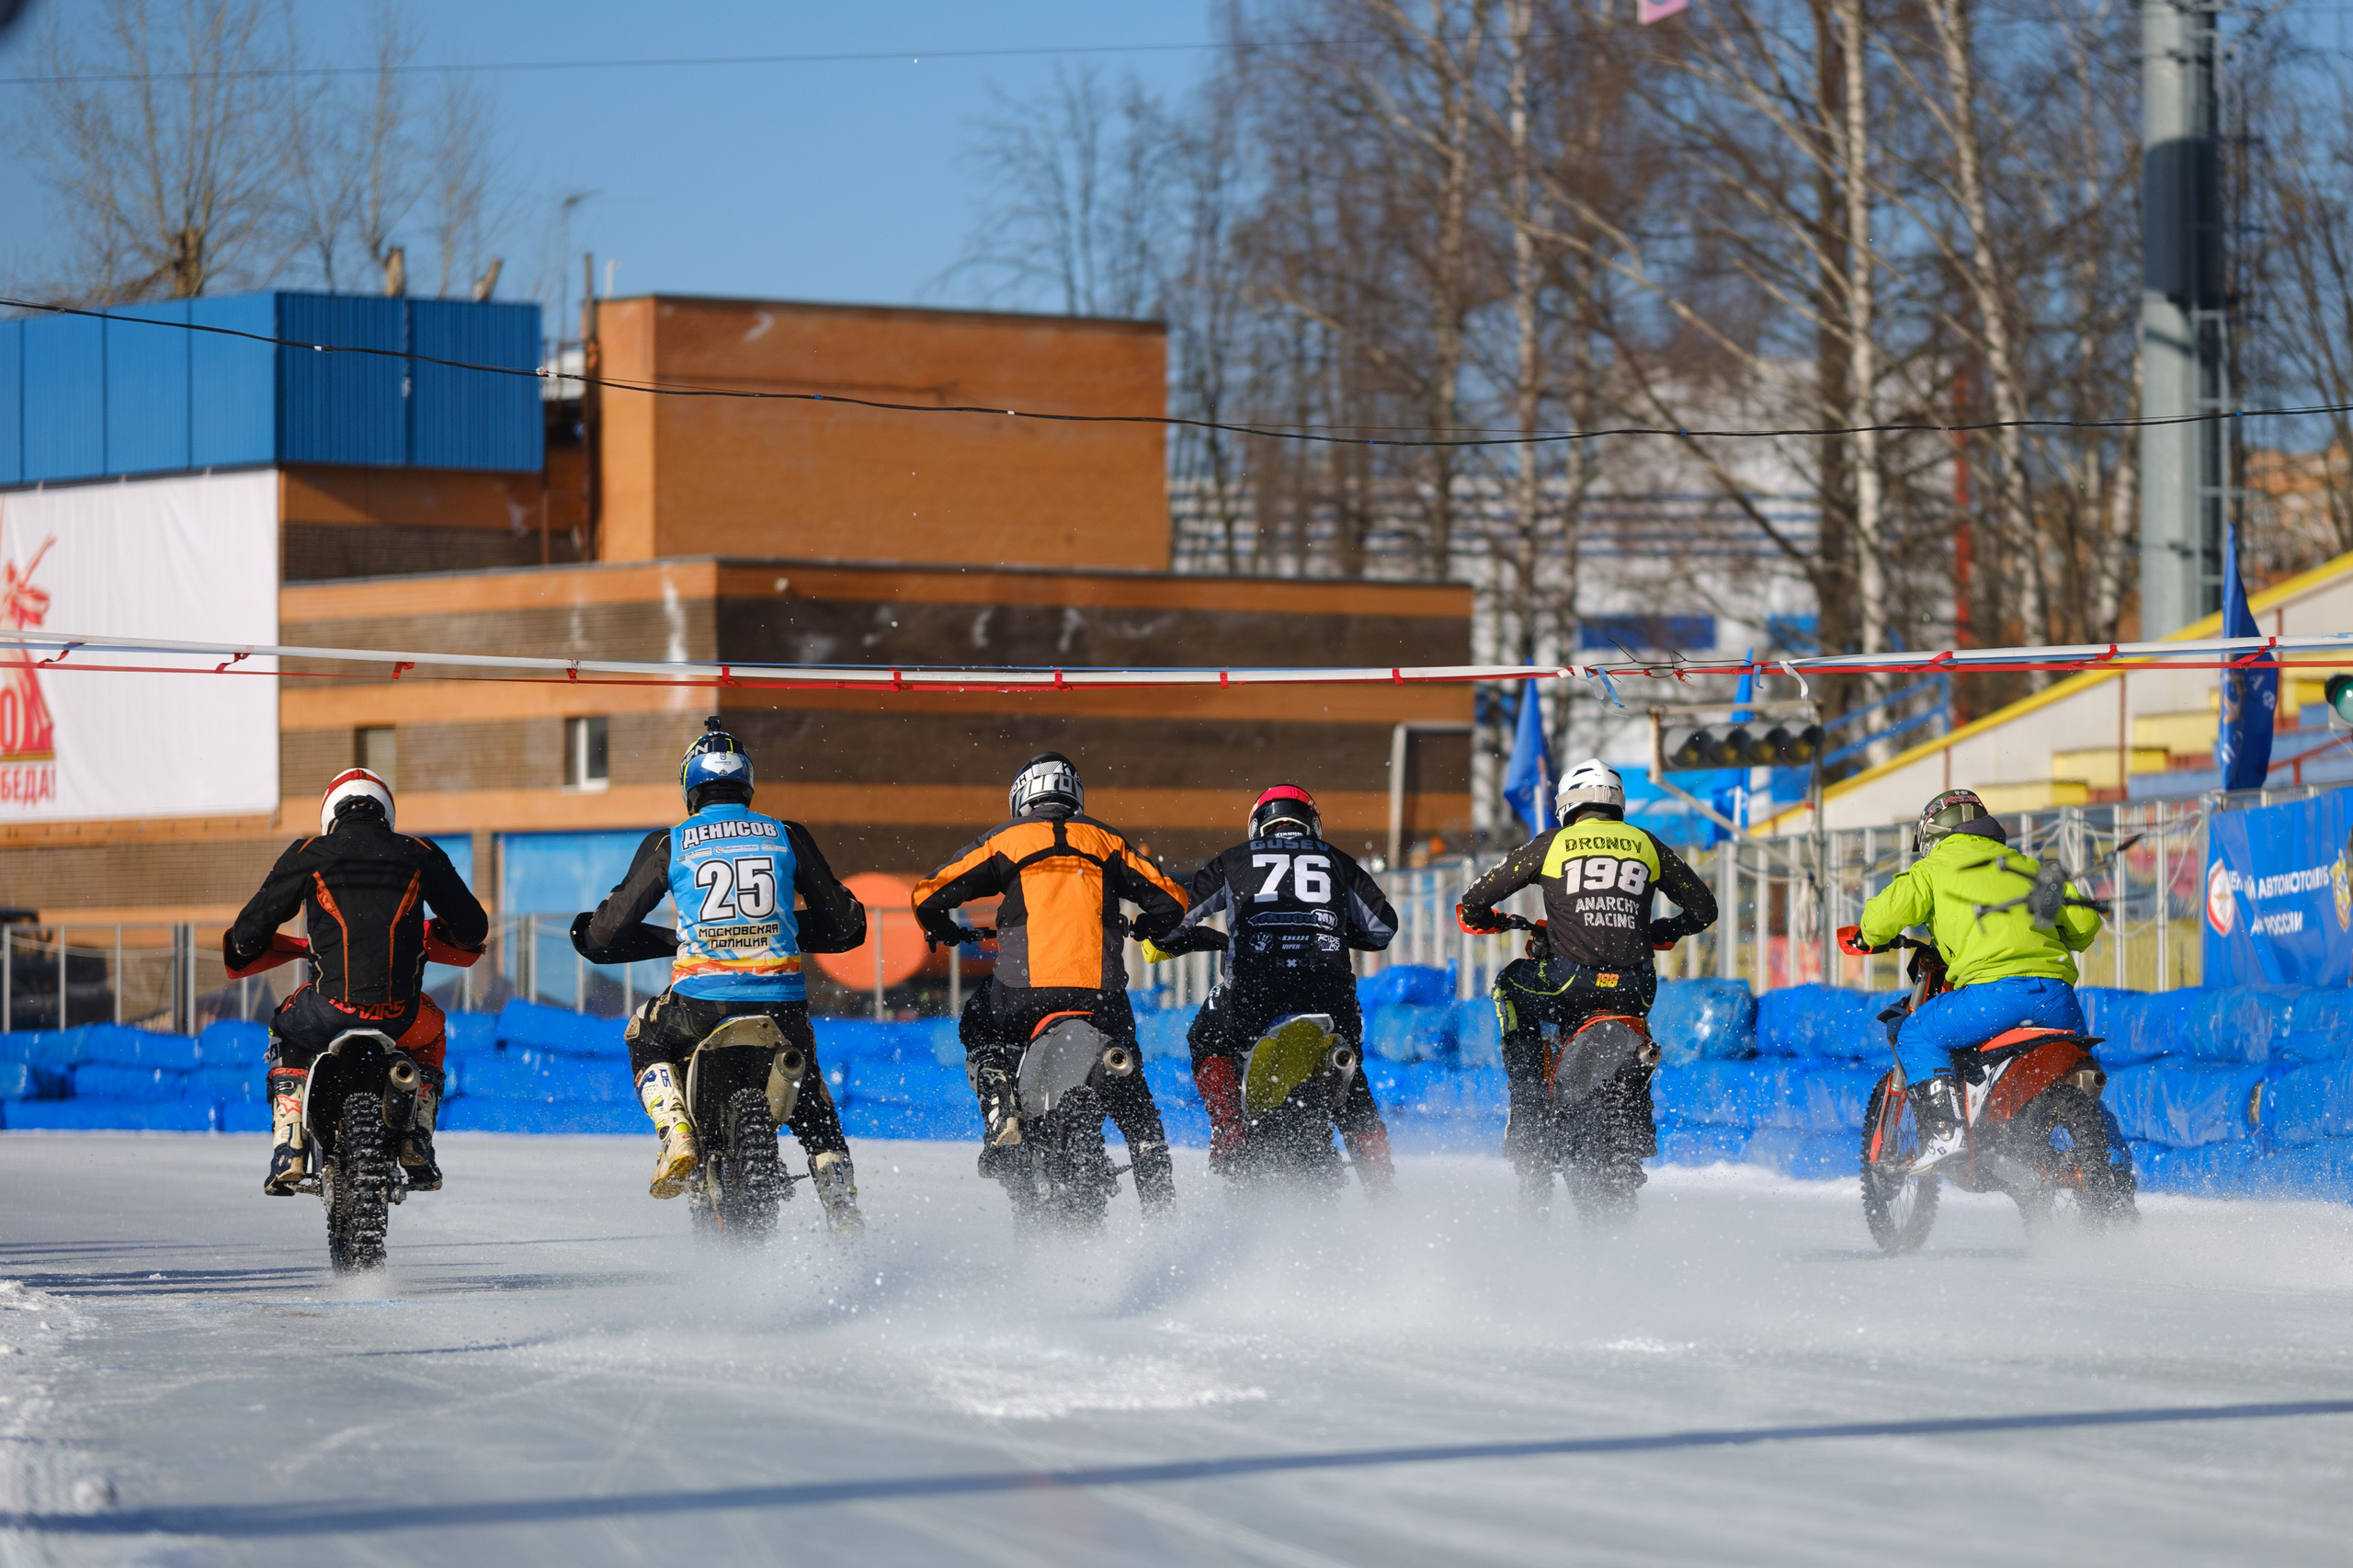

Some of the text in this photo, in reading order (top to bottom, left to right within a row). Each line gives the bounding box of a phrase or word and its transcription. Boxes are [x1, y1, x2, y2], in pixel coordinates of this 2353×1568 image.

[682, 821, 778, 850] ДЕНИСОВ
[1250, 839, 1330, 851] GUSEV
[1565, 836, 1642, 853] DRONOV
[1253, 854, 1331, 903] 76
[1564, 857, 1649, 895] 198
[696, 858, 775, 922] 25
[1575, 896, 1640, 915] ANARCHY
[1584, 913, 1635, 929] RACING
[699, 924, 779, 937] МОСКОВСКАЯ
[710, 937, 767, 948] ПОЛИЦИЯ
[1596, 972, 1620, 987] 198
